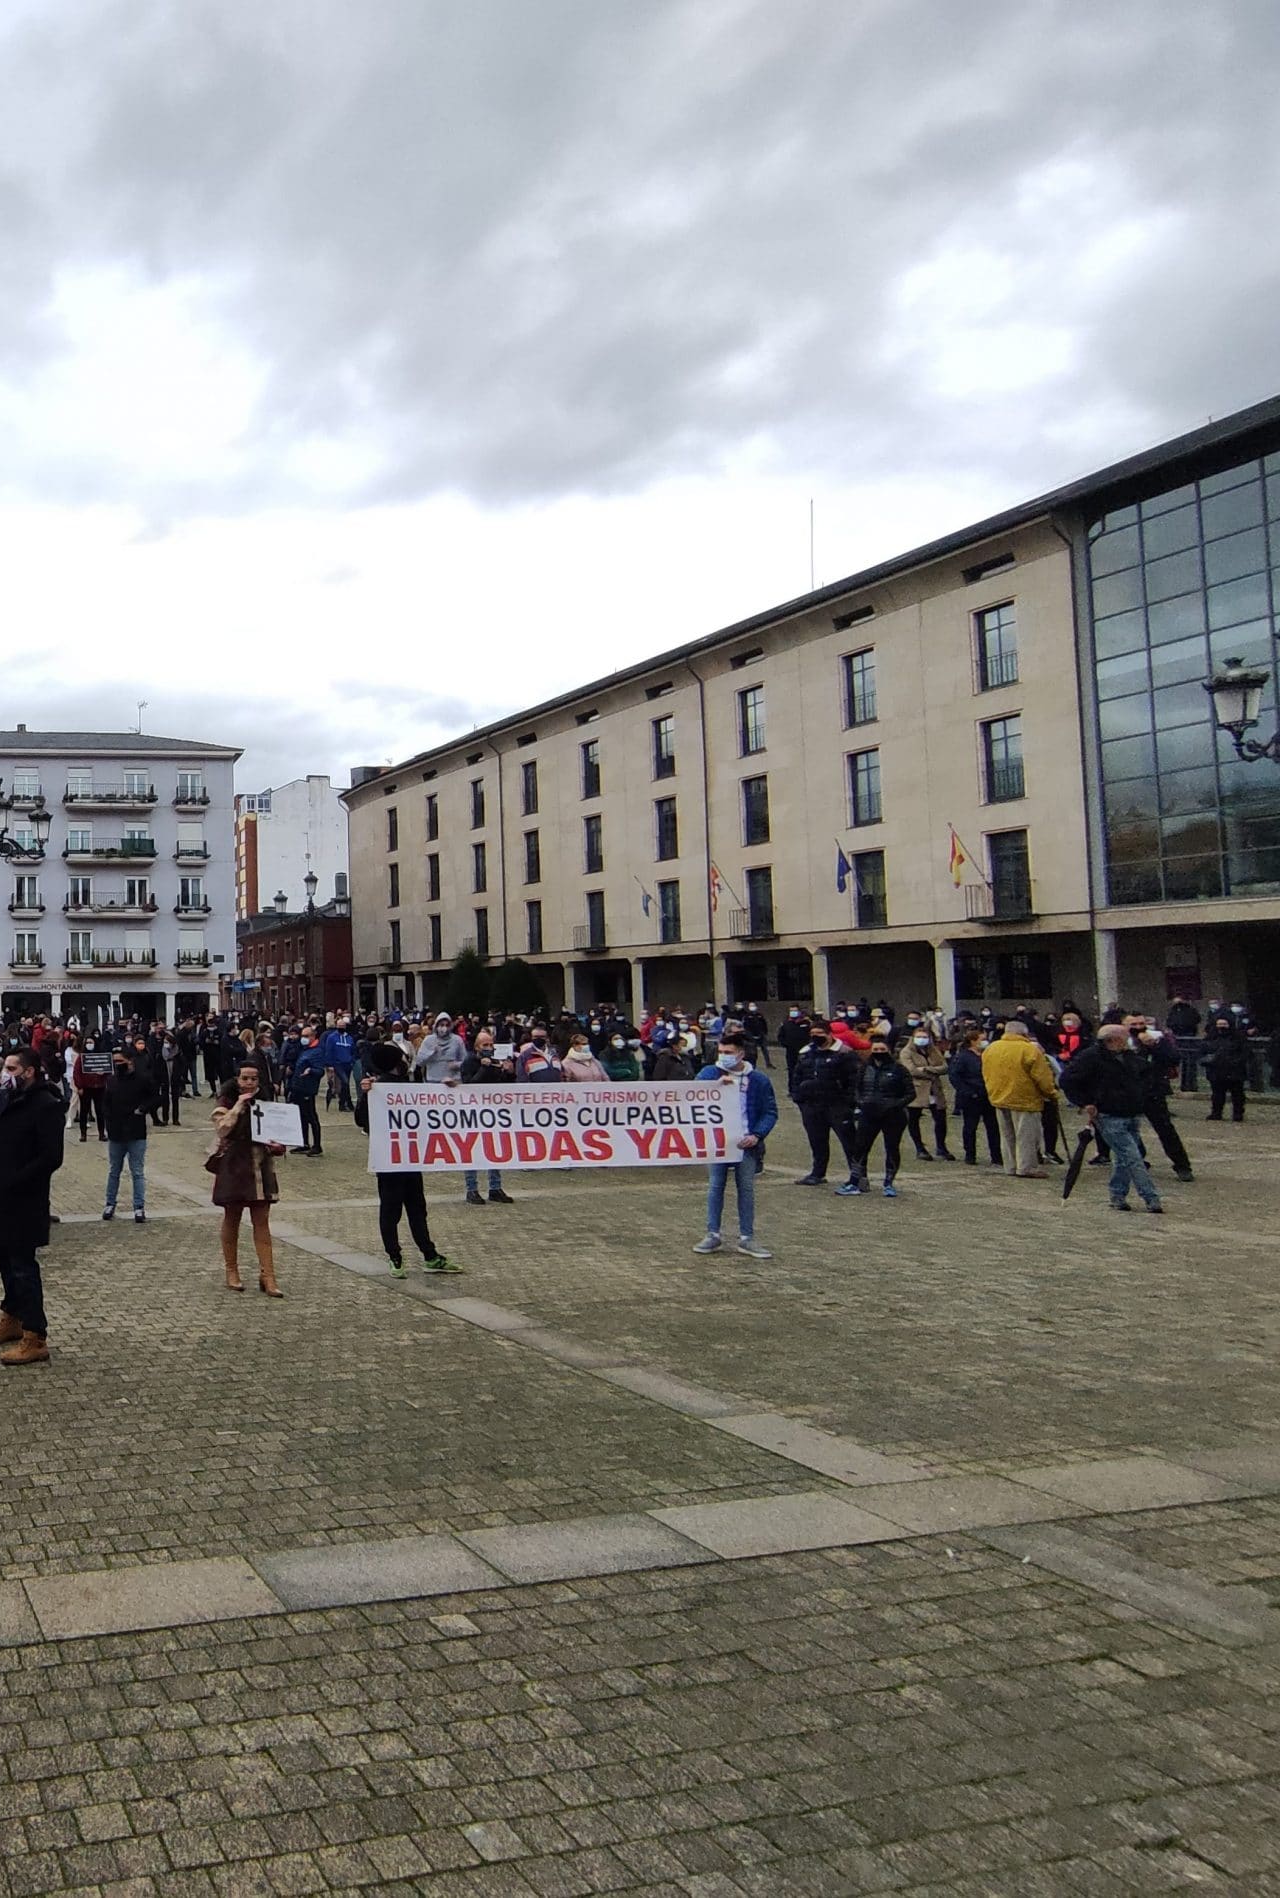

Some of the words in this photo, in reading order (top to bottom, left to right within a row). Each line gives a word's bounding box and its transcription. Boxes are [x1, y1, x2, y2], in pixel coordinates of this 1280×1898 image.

[387, 1093, 455, 1105] SALVEMOS
[461, 1093, 478, 1104] LA
[584, 1091, 648, 1104] TURISMO
[650, 1091, 661, 1102] Y
[665, 1091, 681, 1102] EL
[685, 1089, 721, 1101] OCIO
[388, 1109, 421, 1130] NO
[427, 1108, 512, 1130] SOMOS
[521, 1107, 569, 1128] LOS
[577, 1104, 724, 1127] CULPABLES
[626, 1127, 726, 1160] YA!!
